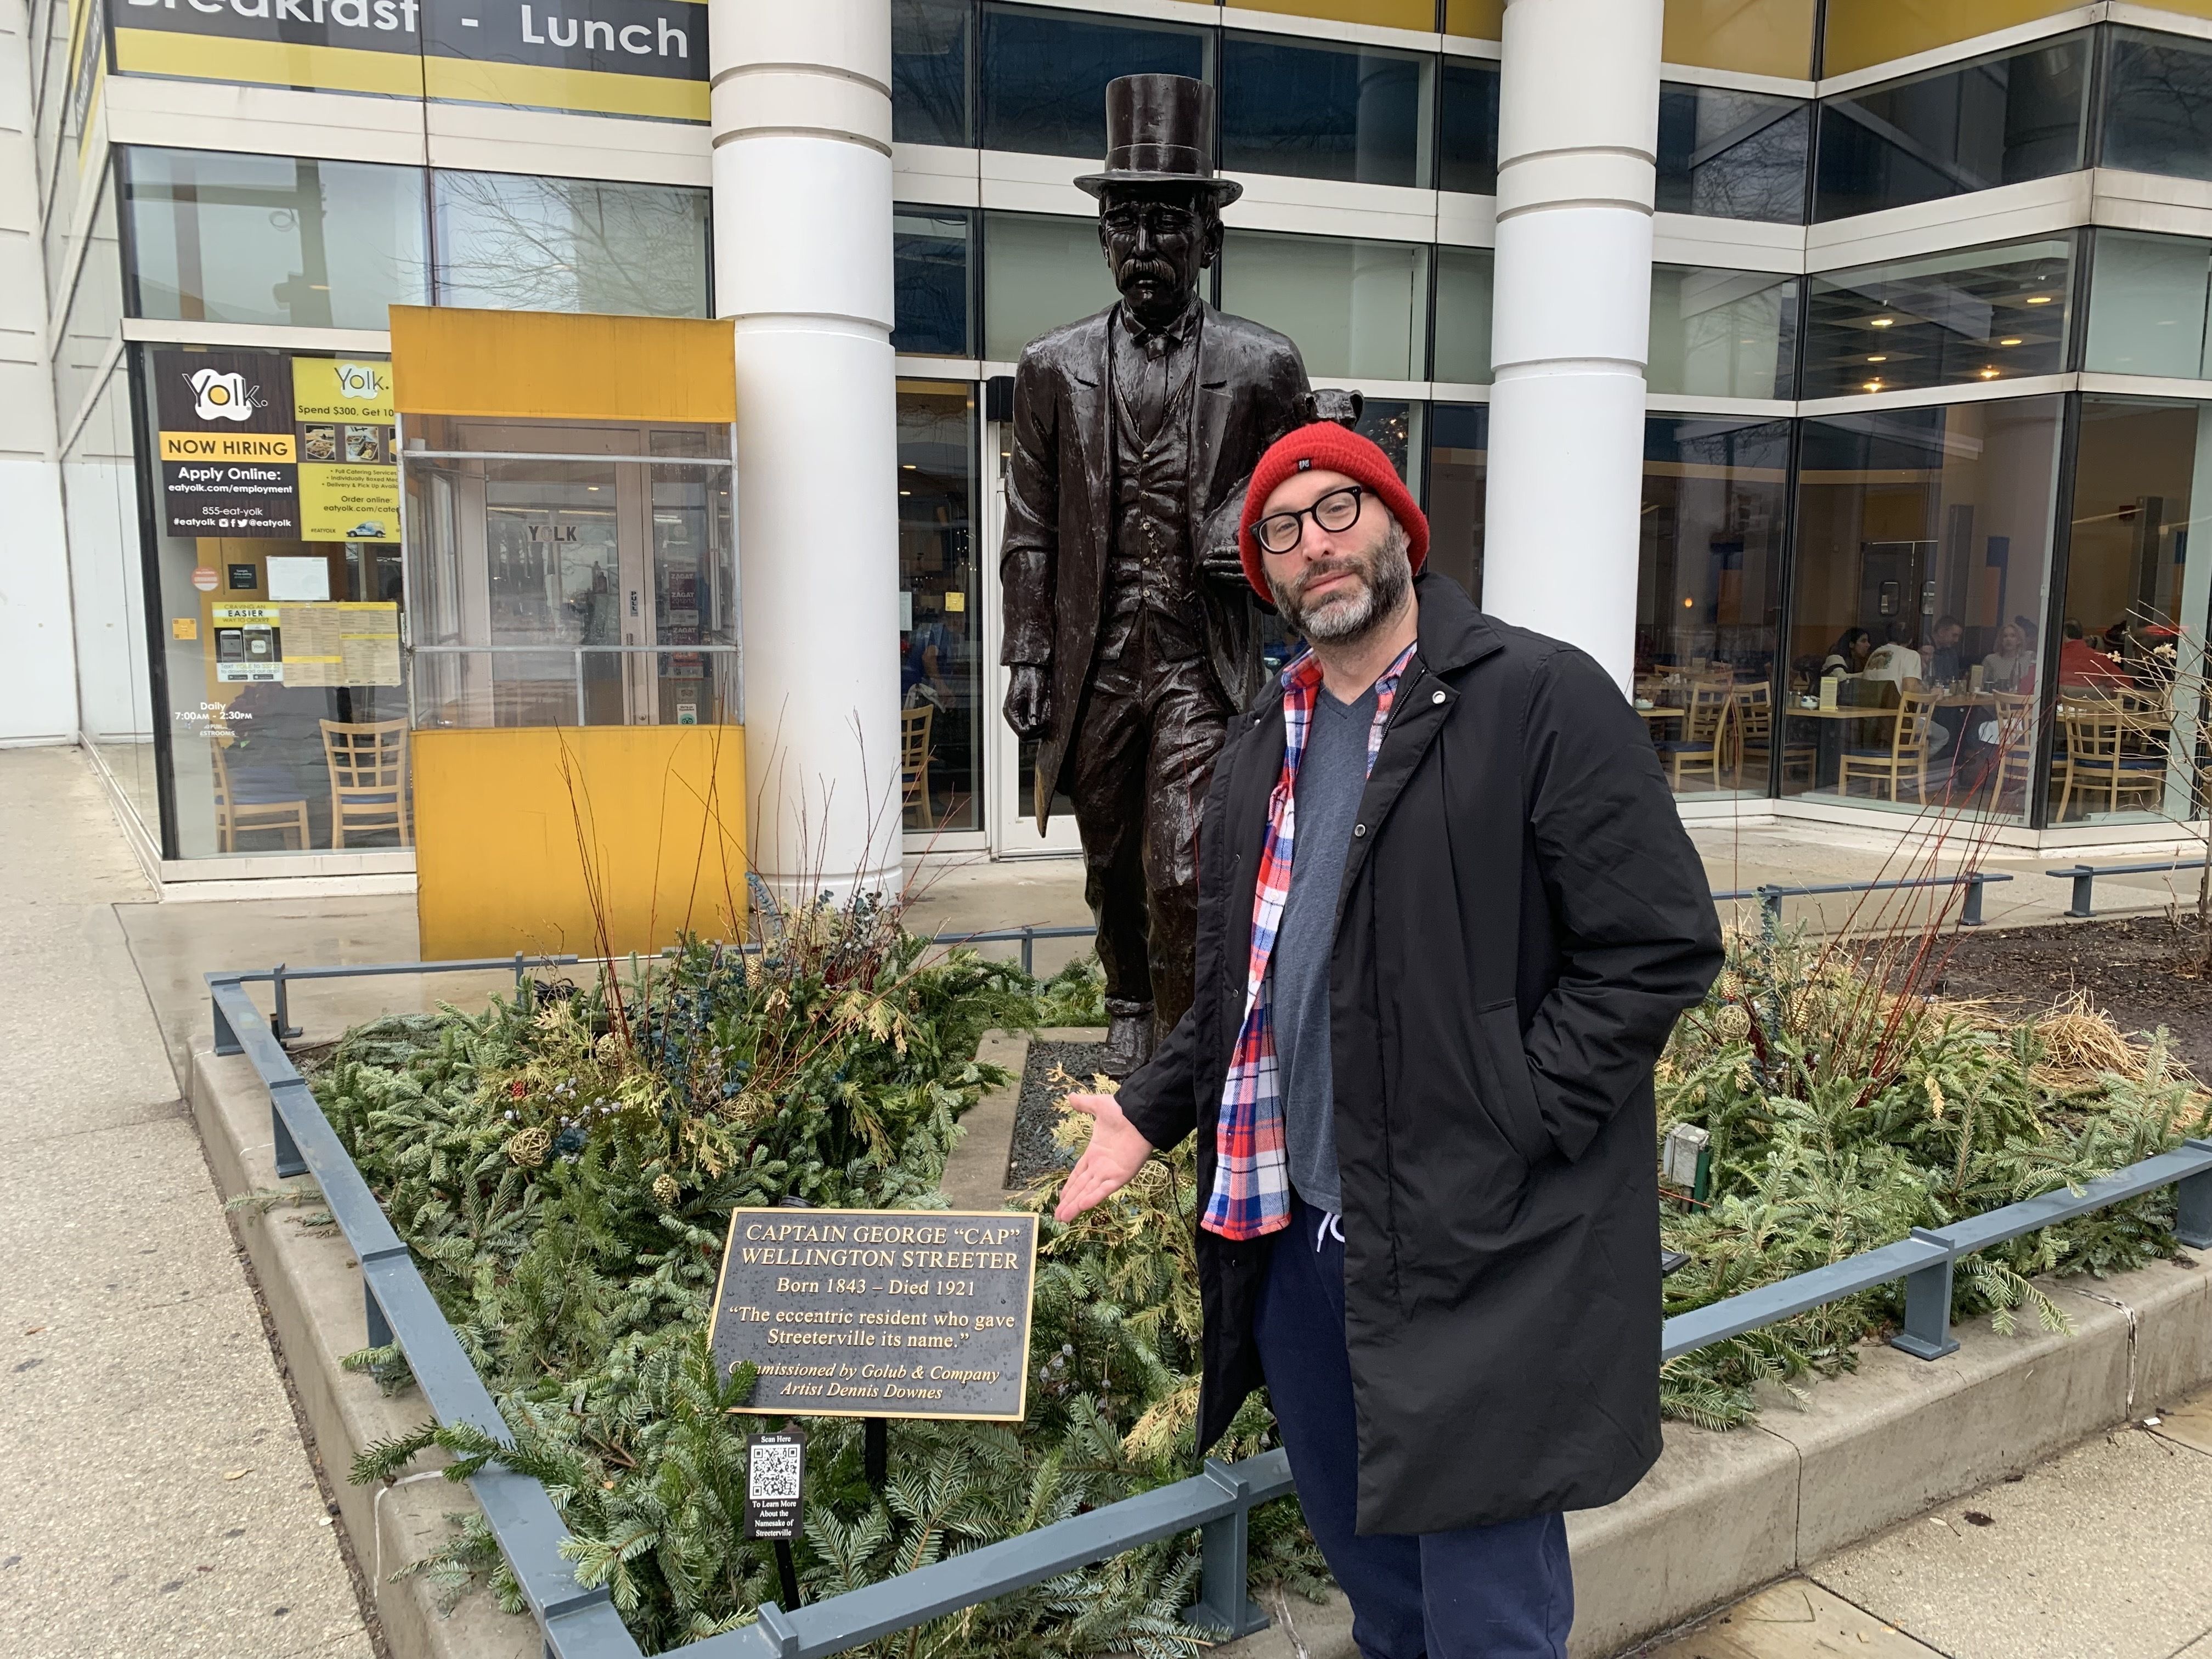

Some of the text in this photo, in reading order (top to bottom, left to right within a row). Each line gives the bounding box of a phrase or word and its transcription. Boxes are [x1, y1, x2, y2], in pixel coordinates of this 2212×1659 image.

[522, 4, 688, 58] Lunch
[298, 405, 330, 414] Spend
[168, 439, 287, 456] NOW HIRING
[178, 467, 281, 482] Apply Online:
[168, 484, 292, 494] eatyolk.com/employment
[202, 506, 263, 517] 855-eat-yolk
[173, 518, 215, 527] #eatyolk
[249, 519, 291, 528] @eatyolk
[201, 702, 226, 711] Daily
[747, 1224, 1020, 1245] CAPTAIN GEORGE “CAP”
[742, 1248, 1019, 1270] WELLINGTON STREETER
[776, 1278, 819, 1293] Born
[827, 1279, 866, 1294] 1843
[889, 1280, 929, 1295] Died
[936, 1281, 974, 1296] 1921
[730, 1306, 1014, 1331] “The eccentric resident who gave
[768, 1329, 969, 1348] Streeterville its name.”
[729, 1361, 1000, 1385] Cmissioned by Golub & Company
[781, 1382, 943, 1400] Artist Dennis Downes
